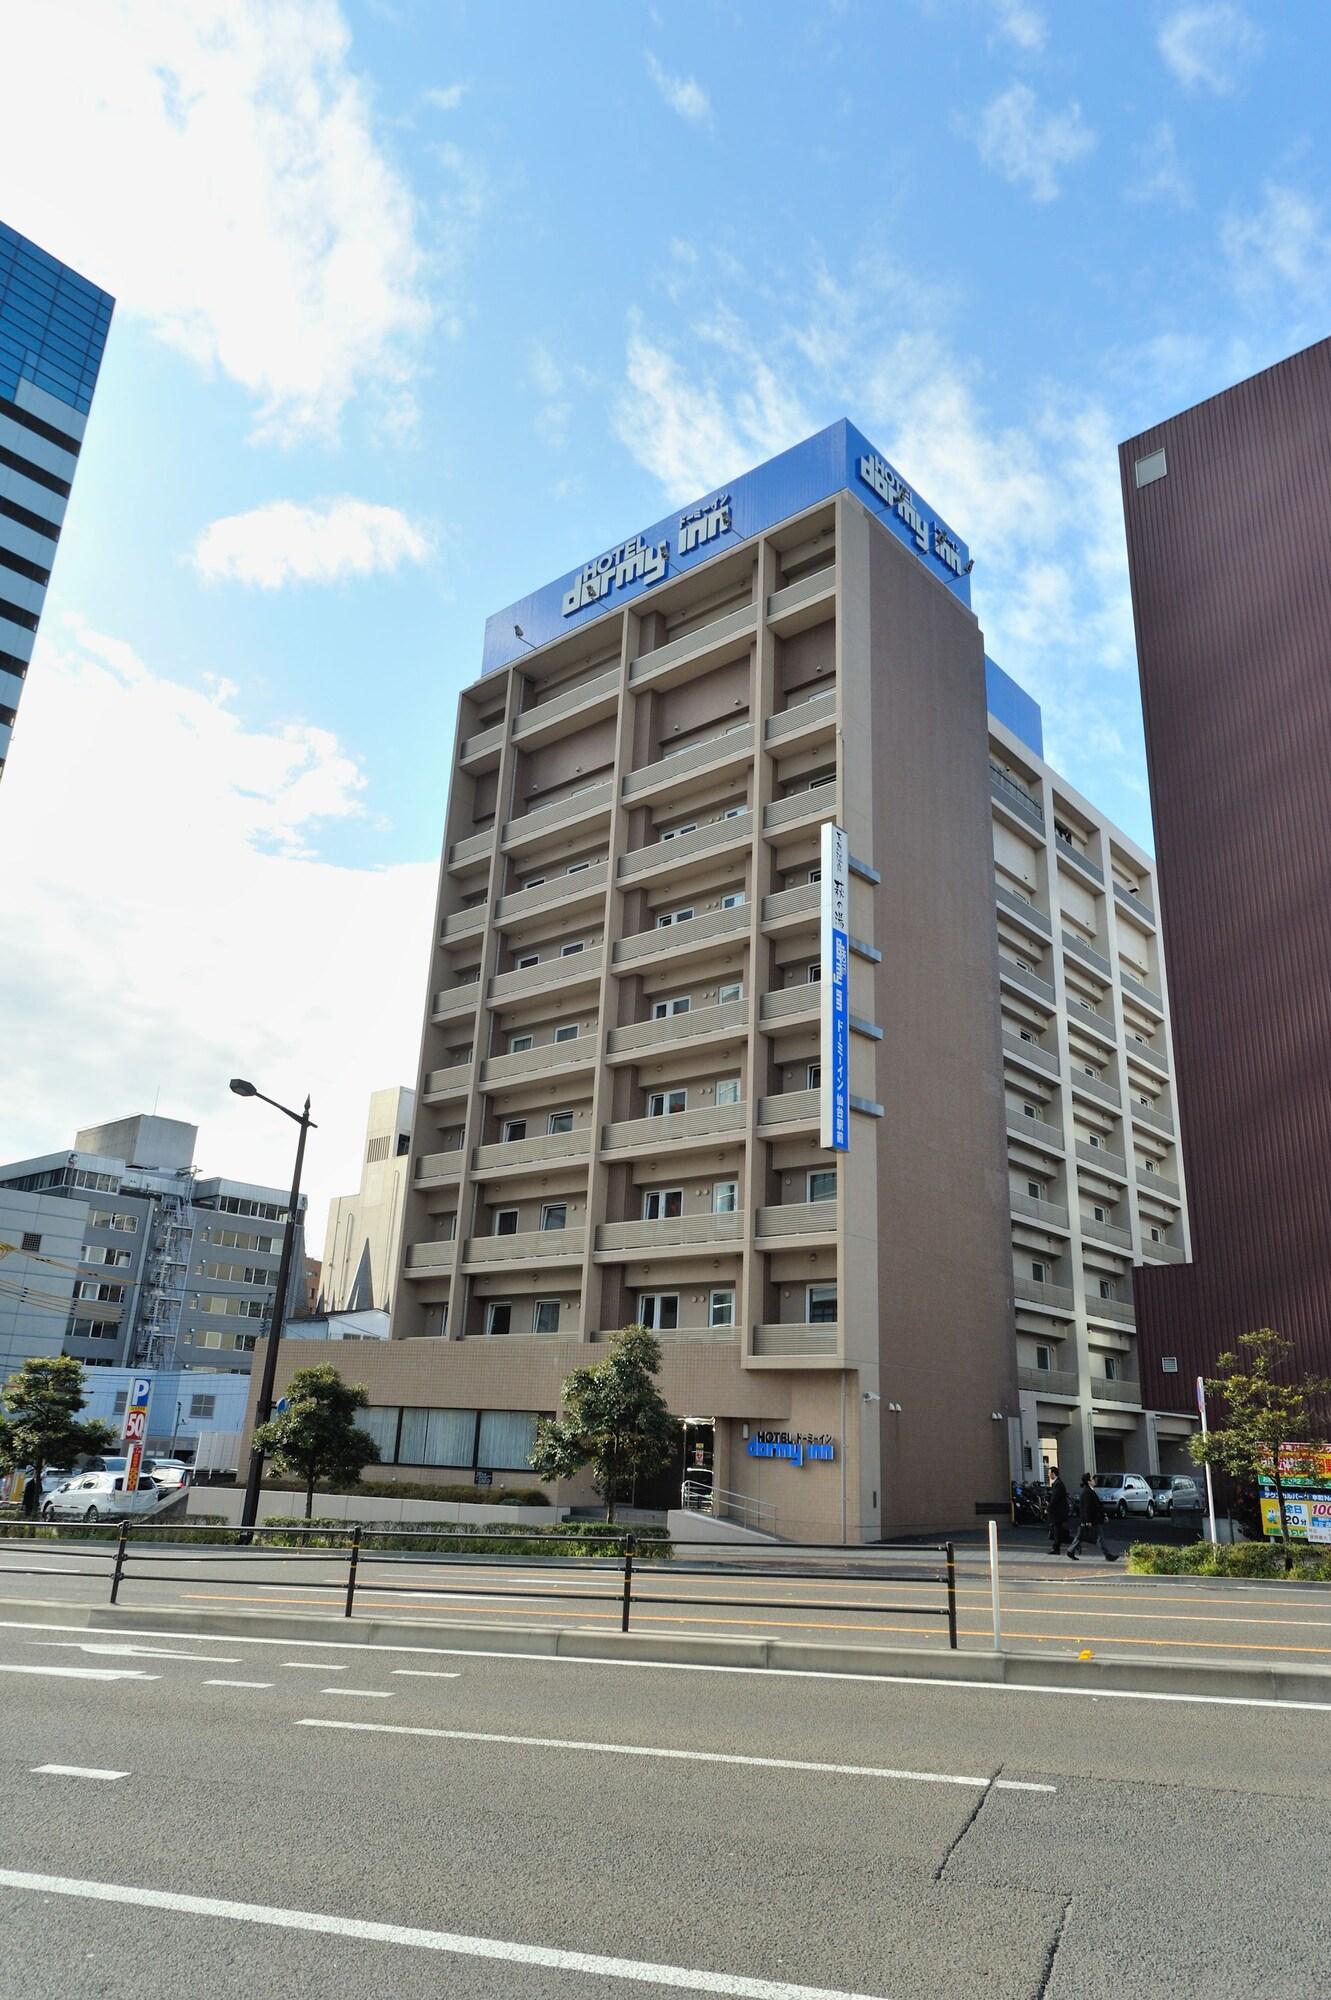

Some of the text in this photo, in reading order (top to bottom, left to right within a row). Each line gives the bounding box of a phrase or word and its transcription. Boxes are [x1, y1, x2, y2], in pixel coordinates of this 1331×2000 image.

[875, 456, 913, 505] HOTEL
[860, 454, 929, 553] dormy
[584, 494, 731, 580] HOTEL ドーミーイン
[562, 506, 731, 617] dormy inn
[132, 1379, 150, 1406] P
[126, 1413, 145, 1438] 50
[758, 1431, 832, 1444] HOTEL ドーミーイン
[747, 1435, 834, 1467] dormy inn
